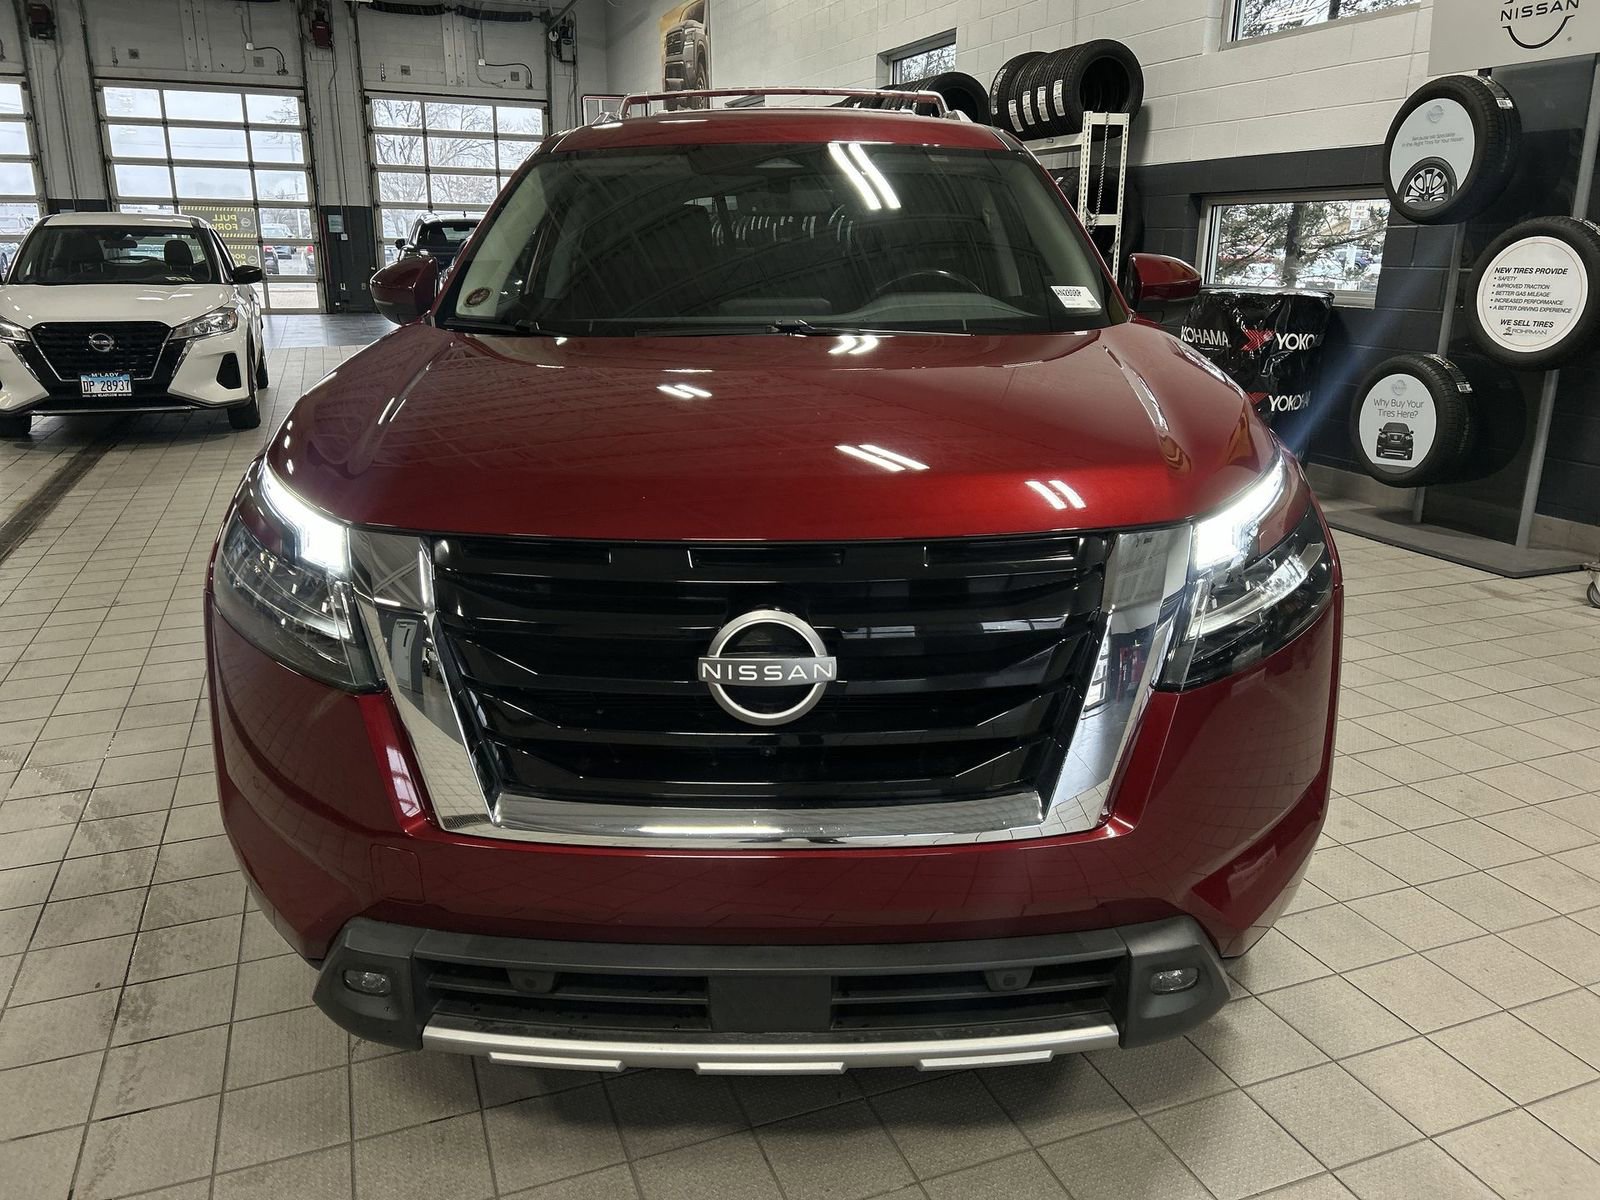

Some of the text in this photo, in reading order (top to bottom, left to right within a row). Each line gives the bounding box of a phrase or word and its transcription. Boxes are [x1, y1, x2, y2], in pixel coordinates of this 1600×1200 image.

[1500, 0, 1579, 21] NISSAN
[1535, 267, 1568, 275] PROVIDE
[1512, 319, 1530, 327] SELL
[1532, 320, 1554, 328] TIRES
[1180, 325, 1229, 347] KOHAMA
[82, 380, 95, 392] DP
[1373, 398, 1425, 409] Why Buy Your
[1378, 408, 1419, 419] Tires Here?
[702, 662, 833, 681] NISSAN
